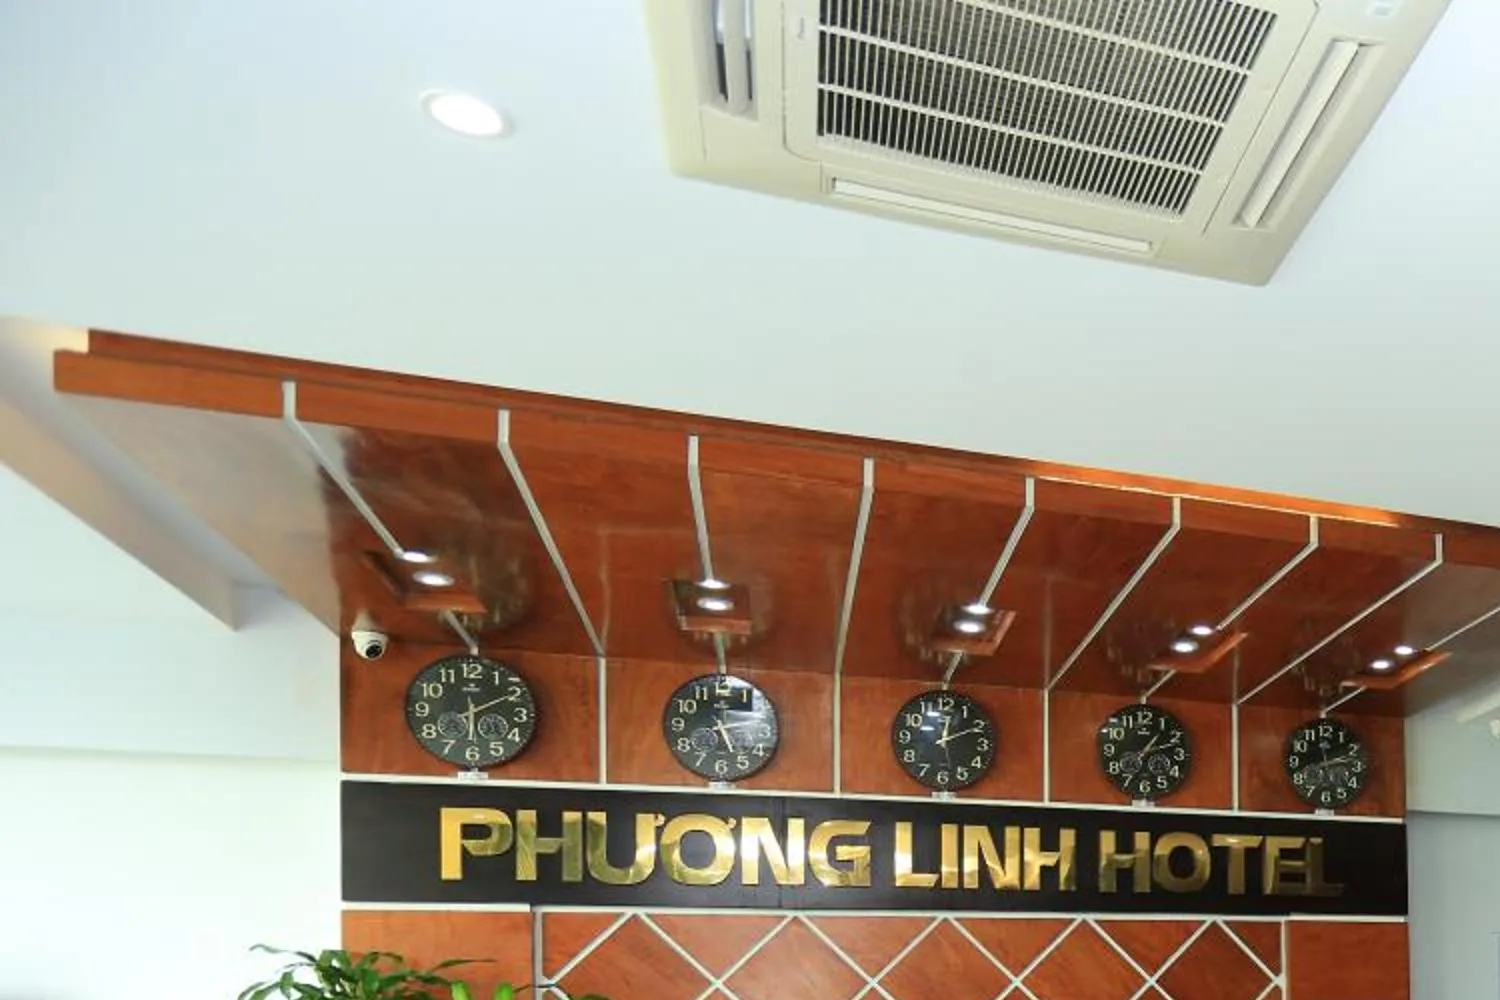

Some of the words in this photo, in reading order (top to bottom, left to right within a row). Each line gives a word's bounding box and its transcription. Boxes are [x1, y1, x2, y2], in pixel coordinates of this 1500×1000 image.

[439, 667, 455, 683] 11
[462, 663, 483, 679] 12
[492, 671, 499, 685] 1
[423, 683, 443, 698] 10
[508, 686, 521, 701] 2
[695, 685, 709, 701] 11
[740, 689, 747, 703] 1
[415, 701, 430, 717] 9
[678, 699, 697, 714] 10
[920, 701, 933, 715] 11
[937, 697, 955, 712] 12
[513, 707, 527, 722] 3
[962, 705, 968, 719] 1
[1135, 711, 1153, 725] 12
[671, 717, 685, 731] 9
[905, 713, 923, 728] 10
[973, 719, 985, 733] 2
[1121, 715, 1133, 729] 11
[1159, 717, 1165, 730] 1
[421, 723, 437, 739] 8
[507, 727, 521, 743] 4
[899, 729, 911, 744] 9
[1108, 727, 1125, 741] 10
[1170, 730, 1181, 743] 2
[1304, 729, 1315, 741] 11
[1318, 725, 1333, 737] 12
[1338, 731, 1344, 743] 1
[442, 739, 456, 754] 7
[489, 741, 504, 756] 5
[677, 737, 691, 752] 8
[752, 743, 765, 757] 4
[976, 738, 989, 752] 3
[1103, 743, 1115, 757] 9
[1293, 740, 1307, 753] 10
[1348, 743, 1357, 756] 2
[465, 746, 480, 761] 6
[694, 751, 707, 767] 7
[903, 749, 915, 763] 8
[1173, 748, 1185, 761] 3
[715, 759, 728, 774] 6
[736, 755, 749, 770] 5
[971, 756, 981, 769] 4
[1109, 761, 1120, 775] 8
[1289, 755, 1299, 768] 9
[1351, 761, 1361, 773] 3
[919, 763, 931, 777] 7
[956, 766, 968, 781] 5
[1169, 765, 1179, 778] 4
[937, 770, 949, 785] 6
[1121, 774, 1133, 787] 7
[1156, 775, 1167, 789] 5
[1293, 772, 1303, 785] 8
[1347, 776, 1357, 789] 4
[1139, 780, 1151, 793] 6
[1305, 785, 1316, 797] 7
[1337, 787, 1347, 799] 5
[1321, 791, 1331, 802] 6
[440, 807, 873, 887] PHƯƠNG
[894, 821, 1077, 891] LINH
[1099, 831, 1345, 897] HOTEL
